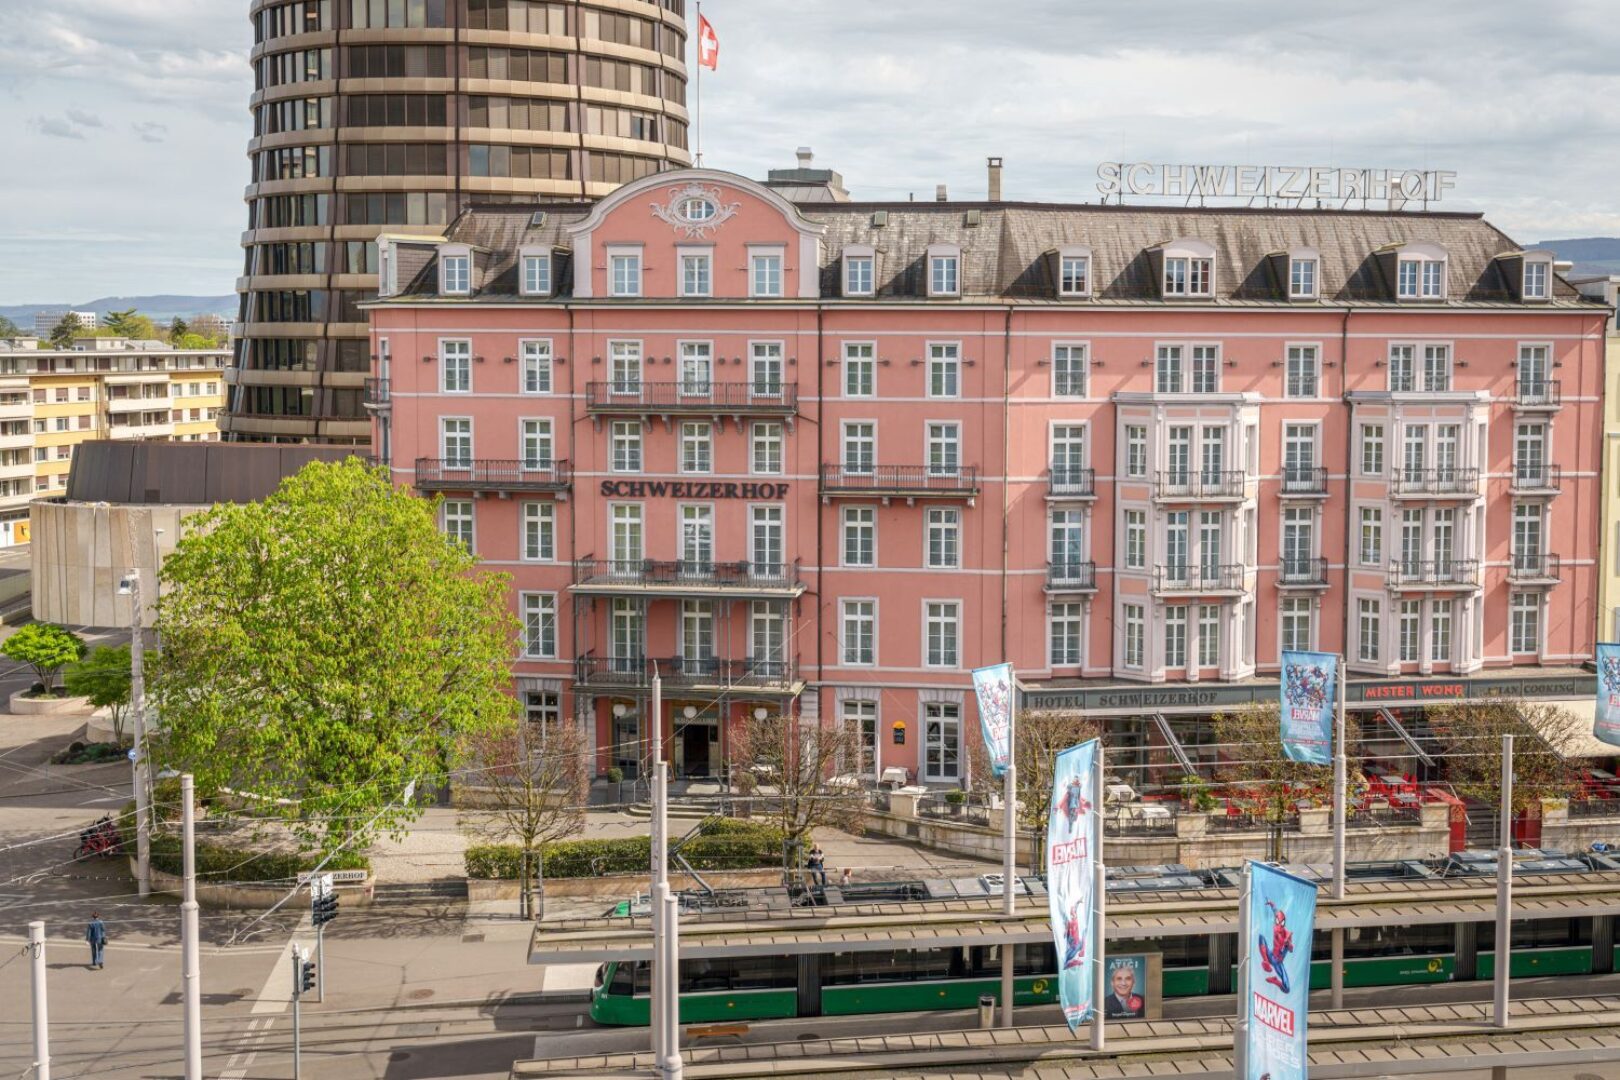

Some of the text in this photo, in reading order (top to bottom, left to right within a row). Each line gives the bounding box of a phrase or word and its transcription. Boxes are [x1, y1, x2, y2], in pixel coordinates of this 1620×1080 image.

[1095, 161, 1457, 201] SCHWEIZERHOF
[600, 479, 790, 500] SCHWEIZERHOF
[1365, 684, 1464, 698] MISTER WONG
[1523, 683, 1574, 695] COOKING
[1034, 691, 1218, 708] HOTEL SCHWEIZERHOF
[1254, 993, 1293, 1036] MARVEL
